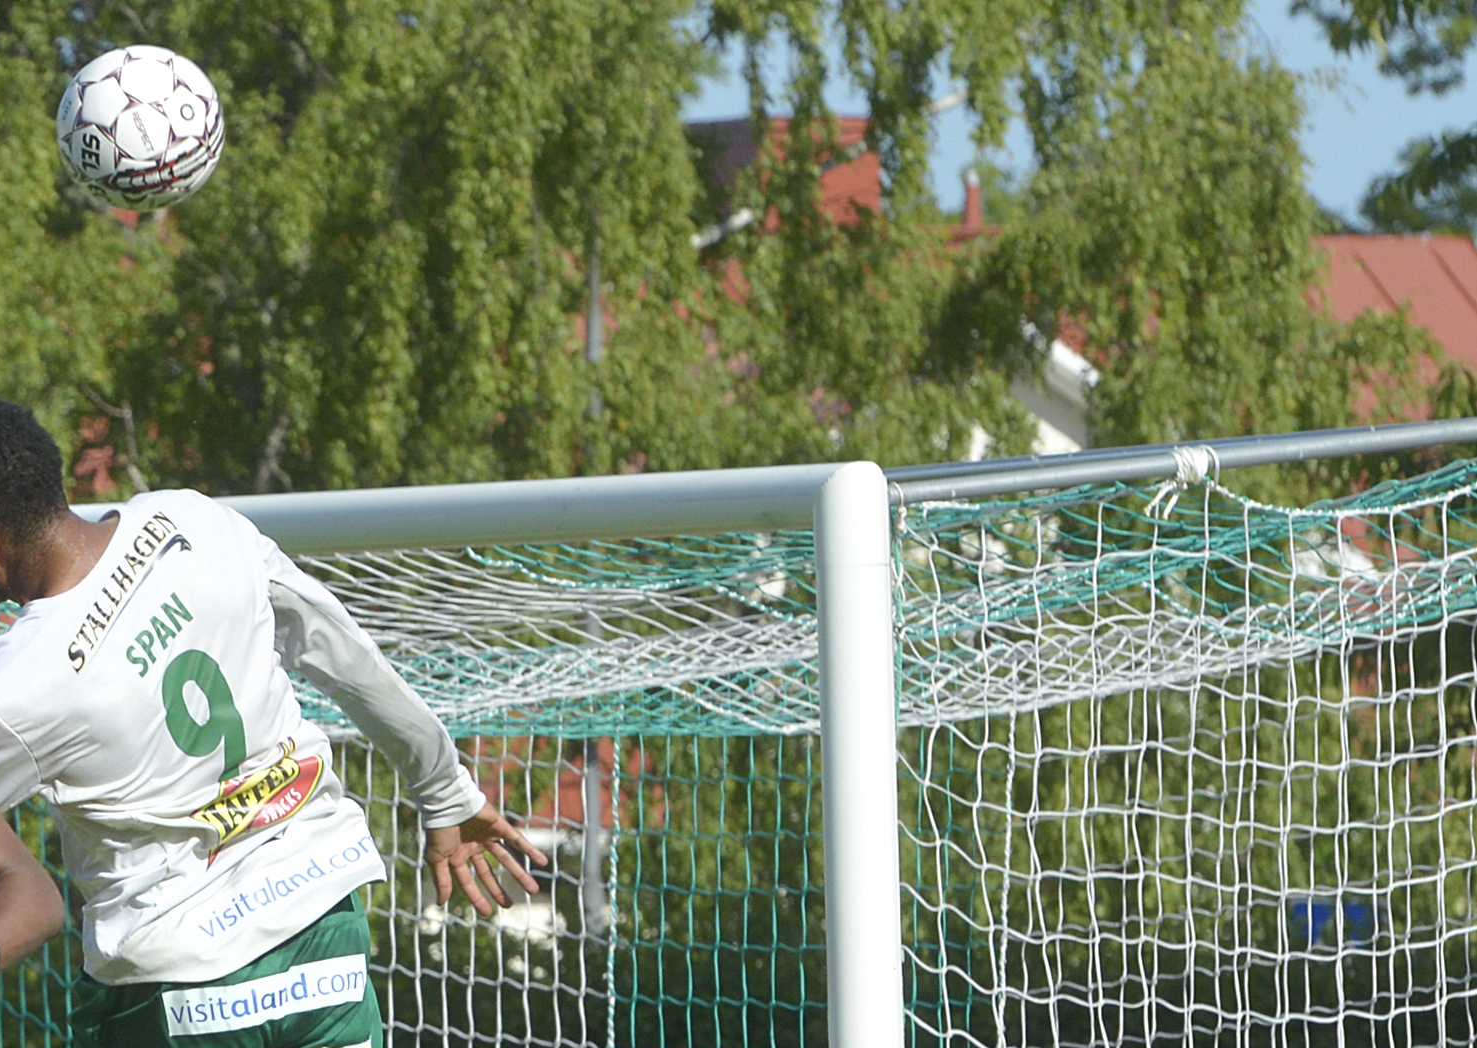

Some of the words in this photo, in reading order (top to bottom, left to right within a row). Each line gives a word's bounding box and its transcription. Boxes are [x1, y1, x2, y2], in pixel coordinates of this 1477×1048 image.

[68, 511, 178, 674] STALLHAGEN
[126, 592, 194, 678] SPAN
[161, 649, 247, 783] 9
[201, 765, 297, 840] TAFFEL
[260, 787, 302, 824] SNACKS
[170, 968, 365, 1025] visitaland.com
